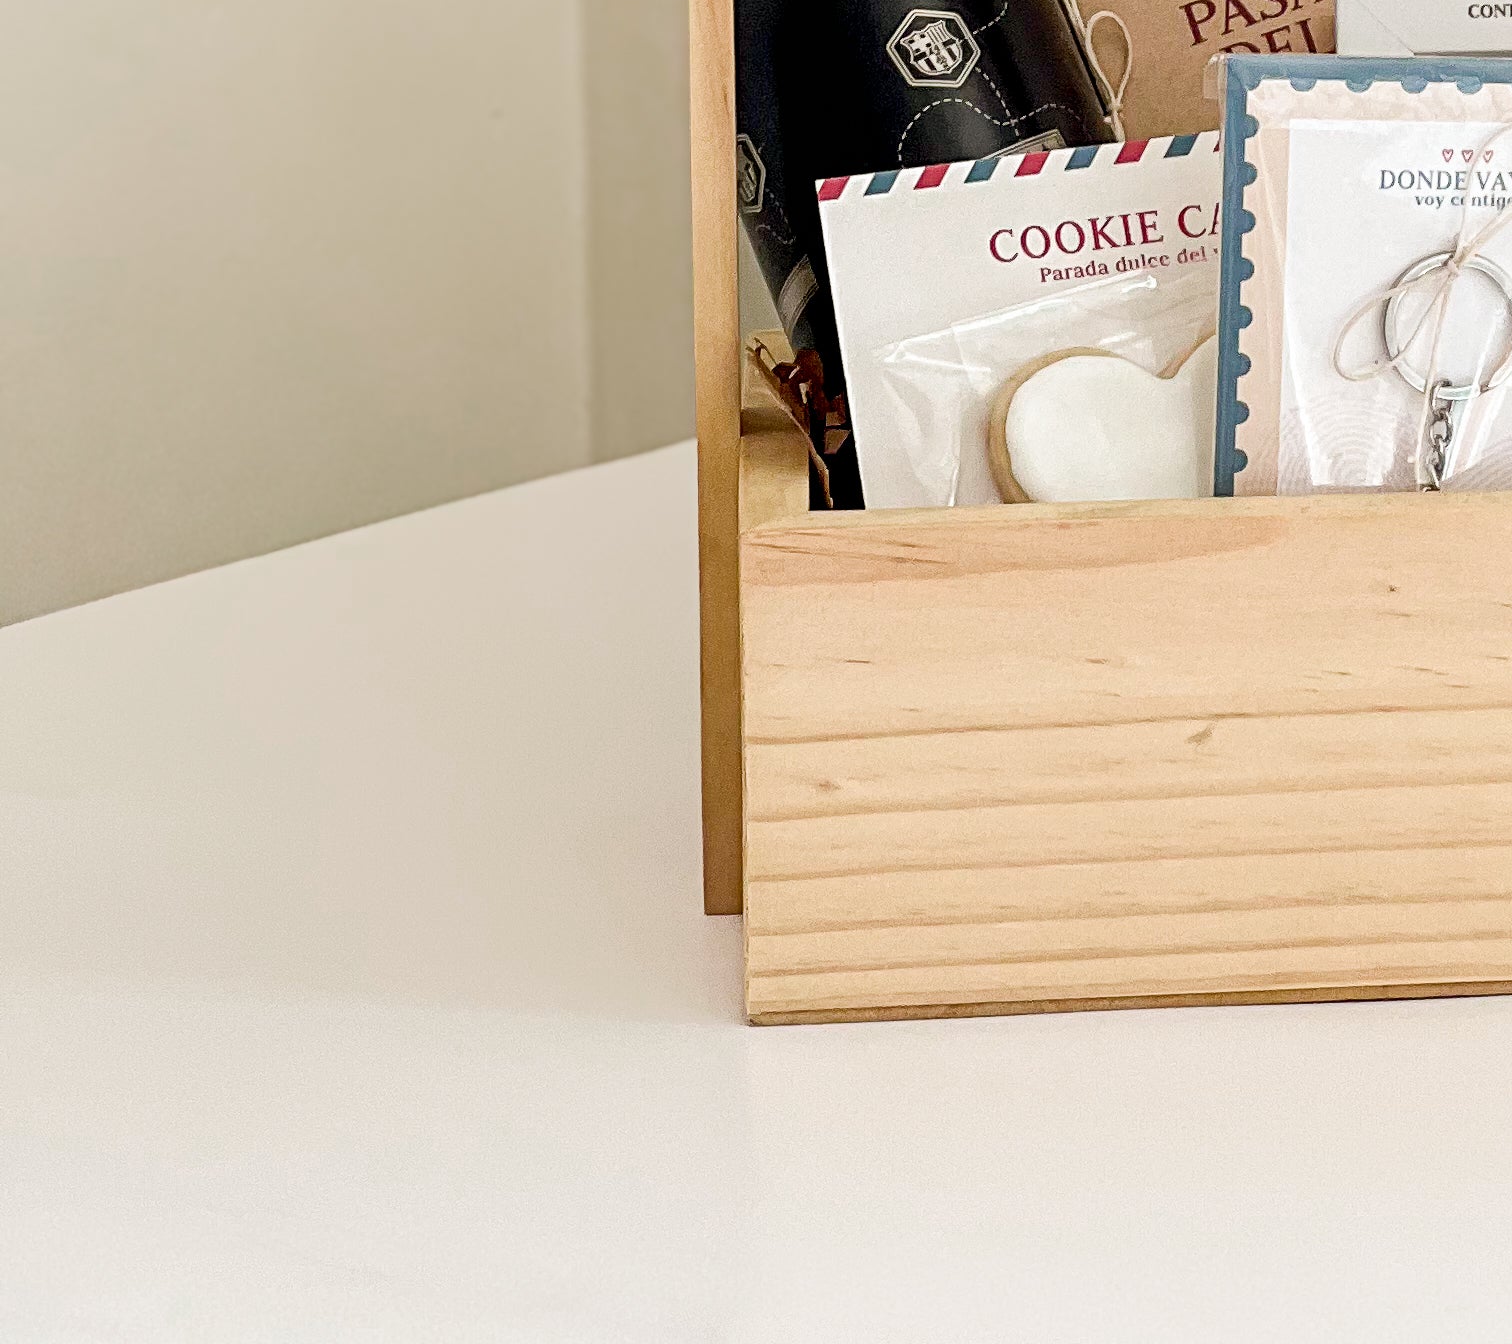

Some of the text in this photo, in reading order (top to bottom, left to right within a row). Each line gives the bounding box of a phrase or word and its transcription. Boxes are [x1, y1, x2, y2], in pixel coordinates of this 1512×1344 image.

[1378, 169, 1468, 191] DONDE
[1414, 194, 1444, 209] voy
[988, 210, 1164, 263] COOKIE
[1040, 260, 1109, 283] Parada
[1115, 254, 1170, 273] dulce
[1177, 246, 1207, 264] del
